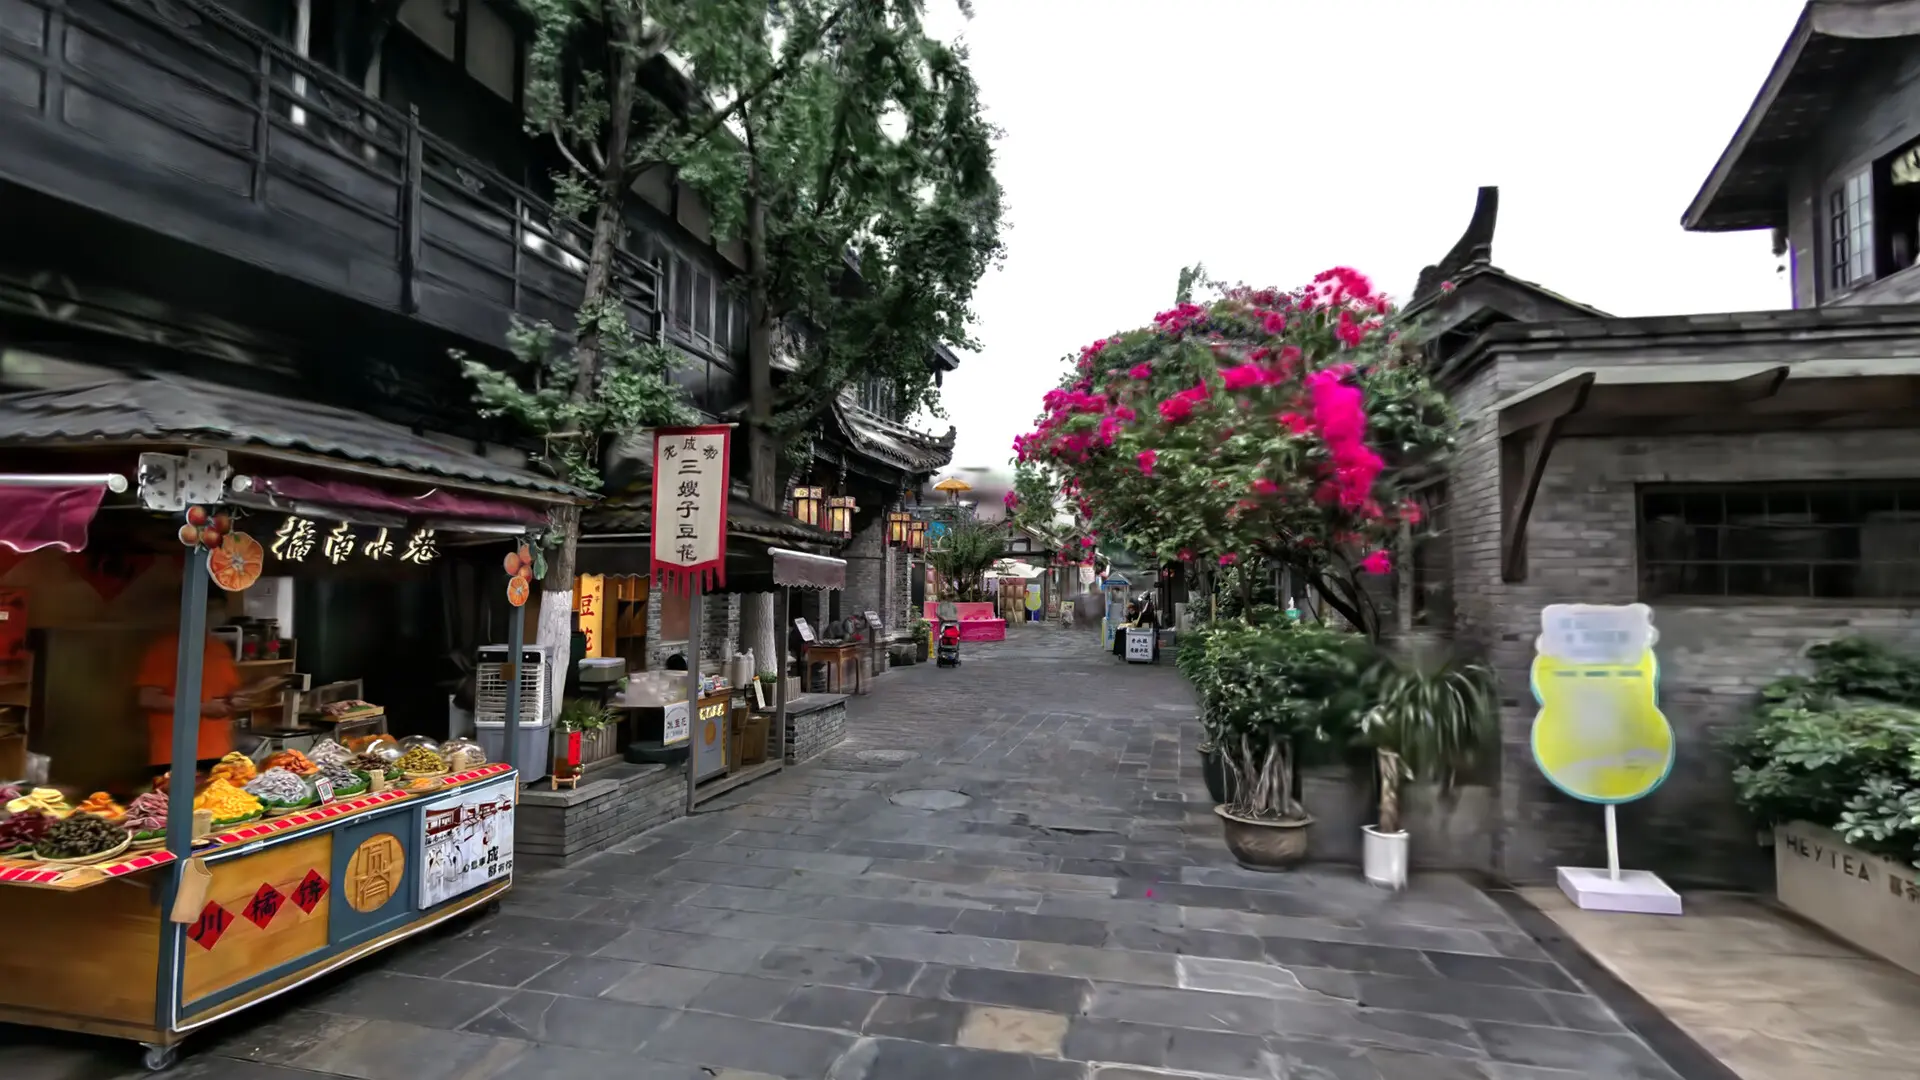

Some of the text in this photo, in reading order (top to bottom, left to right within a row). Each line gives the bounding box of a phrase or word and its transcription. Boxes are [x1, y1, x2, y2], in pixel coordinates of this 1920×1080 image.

[675, 459, 703, 563] 三嫂子豆花
[1786, 834, 1871, 882] HEYTEA
